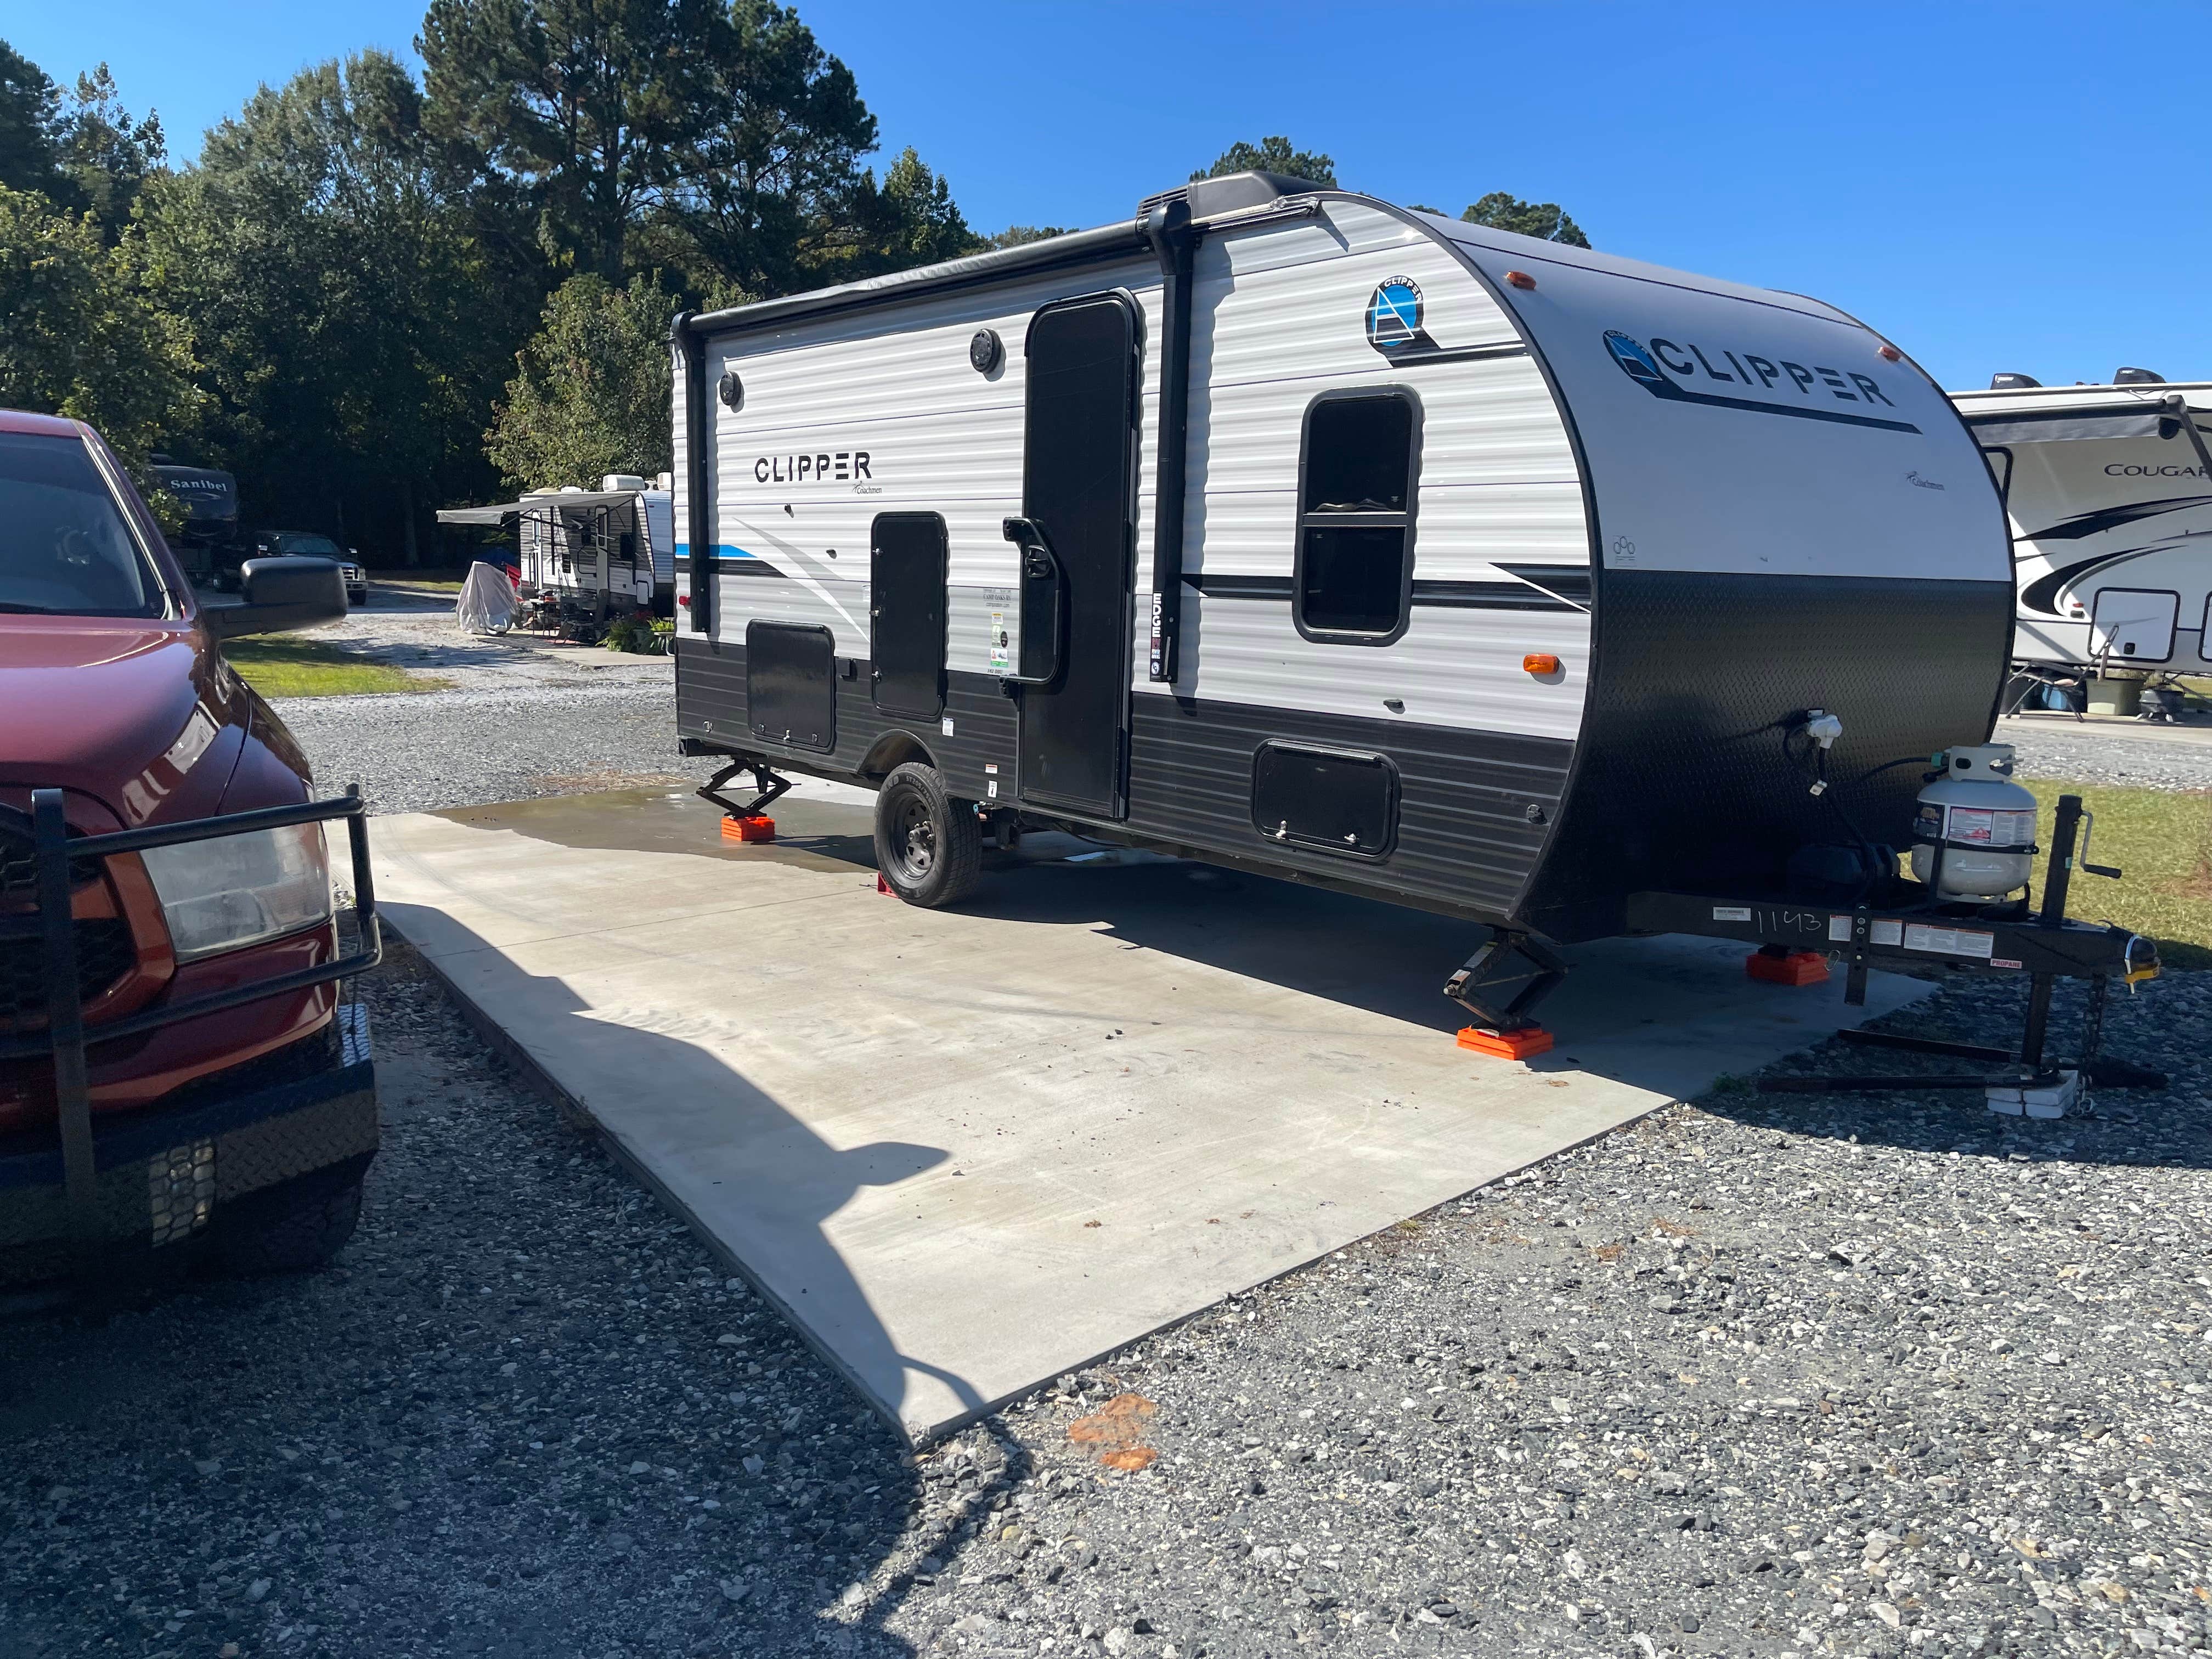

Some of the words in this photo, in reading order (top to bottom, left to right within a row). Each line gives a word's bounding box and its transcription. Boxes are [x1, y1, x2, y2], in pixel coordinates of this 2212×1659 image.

[1384, 276, 1422, 303] CLIPPER
[1650, 338, 1896, 407] CLIPPER
[754, 452, 872, 483] CLIPPER
[171, 479, 227, 492] Sanibel
[857, 486, 882, 494] Coachmen
[1152, 593, 1162, 637] EDGE
[1757, 910, 1821, 933] 1143
[1992, 960, 2021, 968] PROPANE
